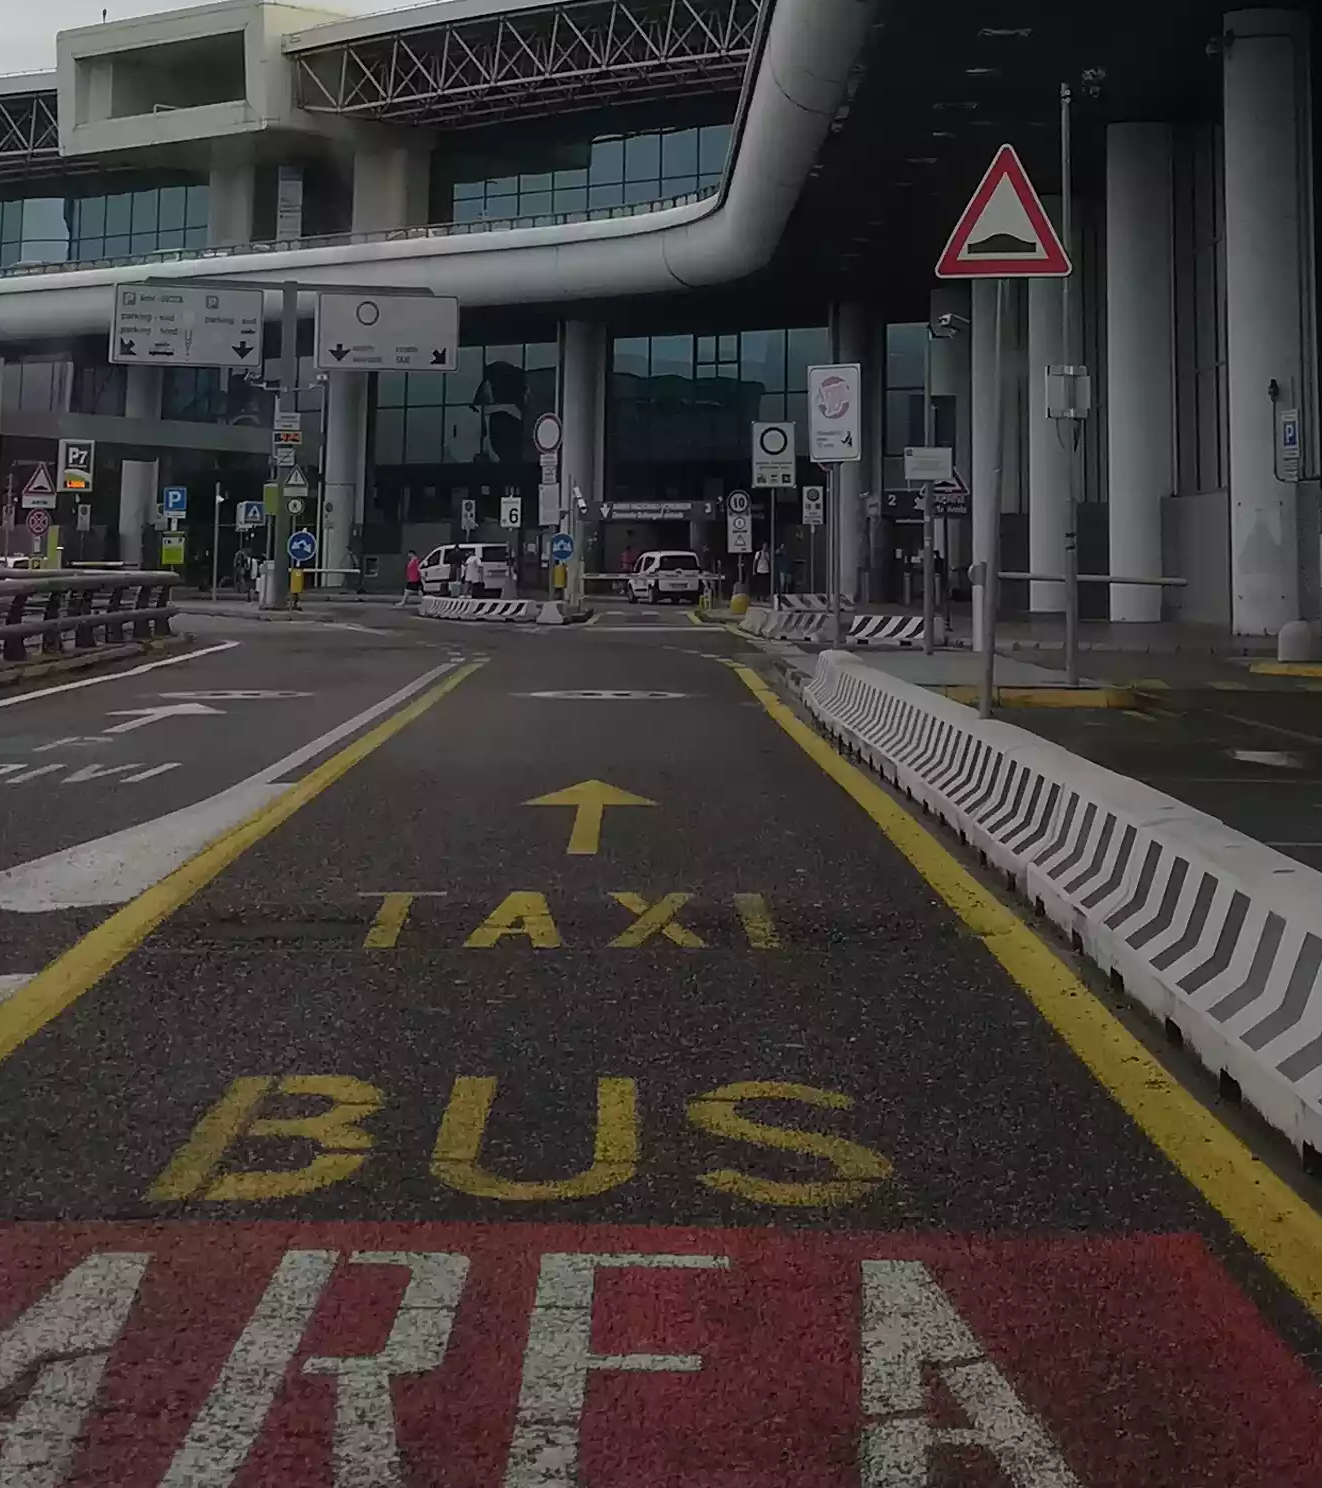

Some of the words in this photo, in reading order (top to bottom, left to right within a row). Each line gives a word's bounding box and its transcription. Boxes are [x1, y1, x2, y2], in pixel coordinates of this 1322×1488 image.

[1285, 423, 1294, 444] P
[68, 447, 88, 465] P7
[168, 491, 182, 509] P
[733, 497, 745, 509] 10
[887, 494, 897, 507] 2
[508, 508, 519, 524] 6
[359, 890, 779, 950] TAXI
[145, 1074, 893, 1208] BUS
